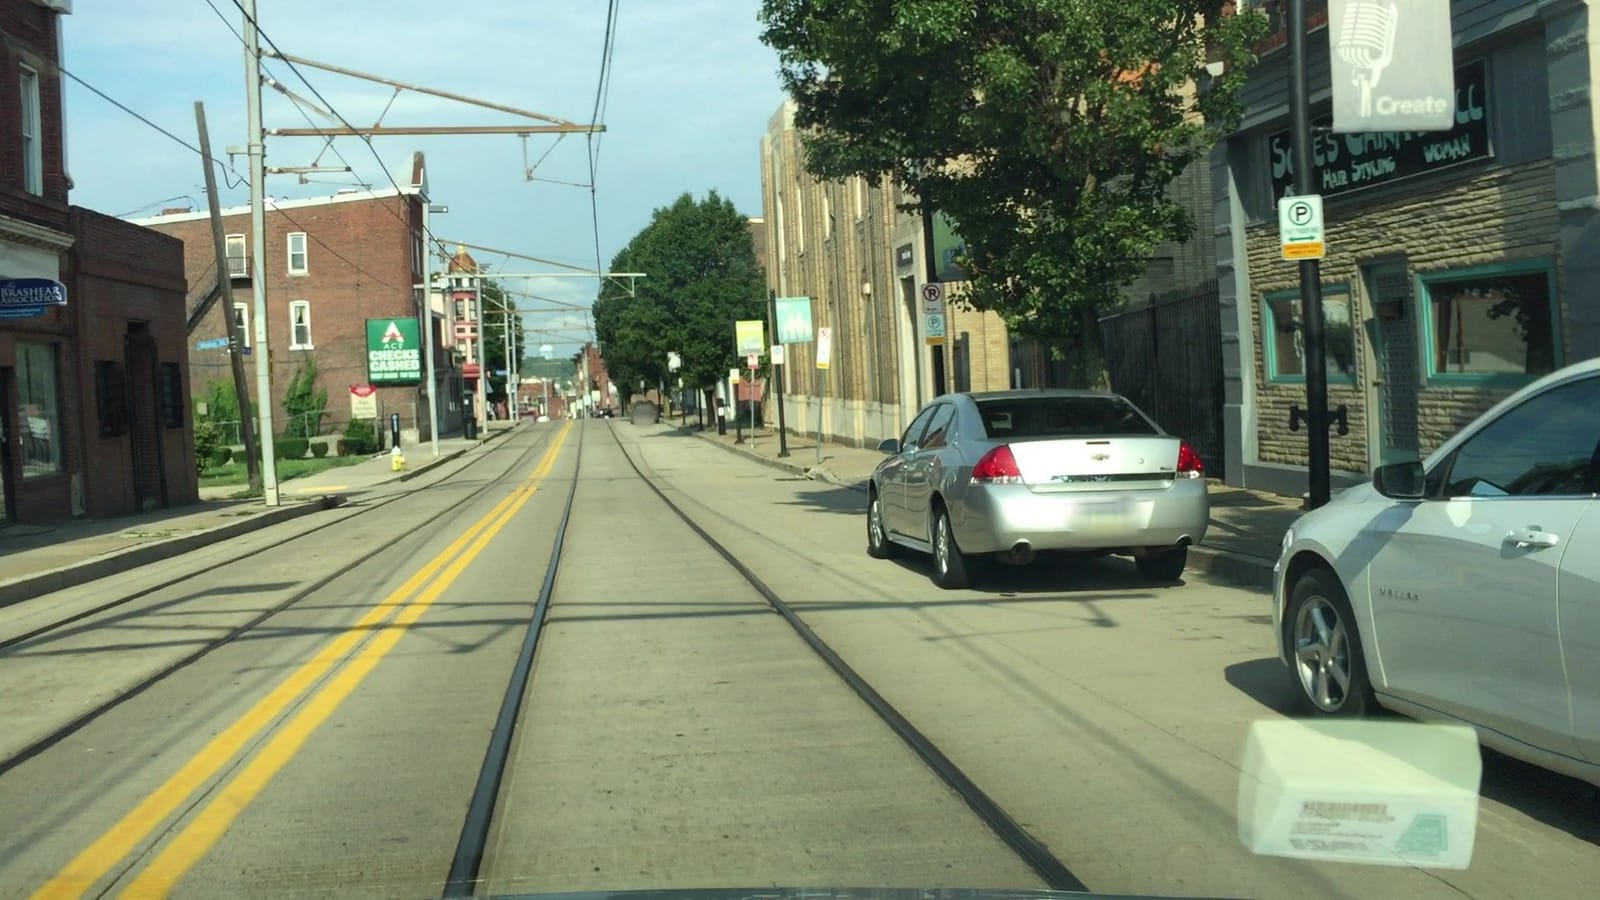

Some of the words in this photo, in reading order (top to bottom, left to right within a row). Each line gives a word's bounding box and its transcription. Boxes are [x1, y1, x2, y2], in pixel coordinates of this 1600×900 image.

[1376, 95, 1447, 115] Create
[1352, 156, 1396, 182] STYLING
[1425, 135, 1471, 163] WOMAN
[369, 349, 419, 361] CHECKS
[369, 360, 420, 372] CASHED
